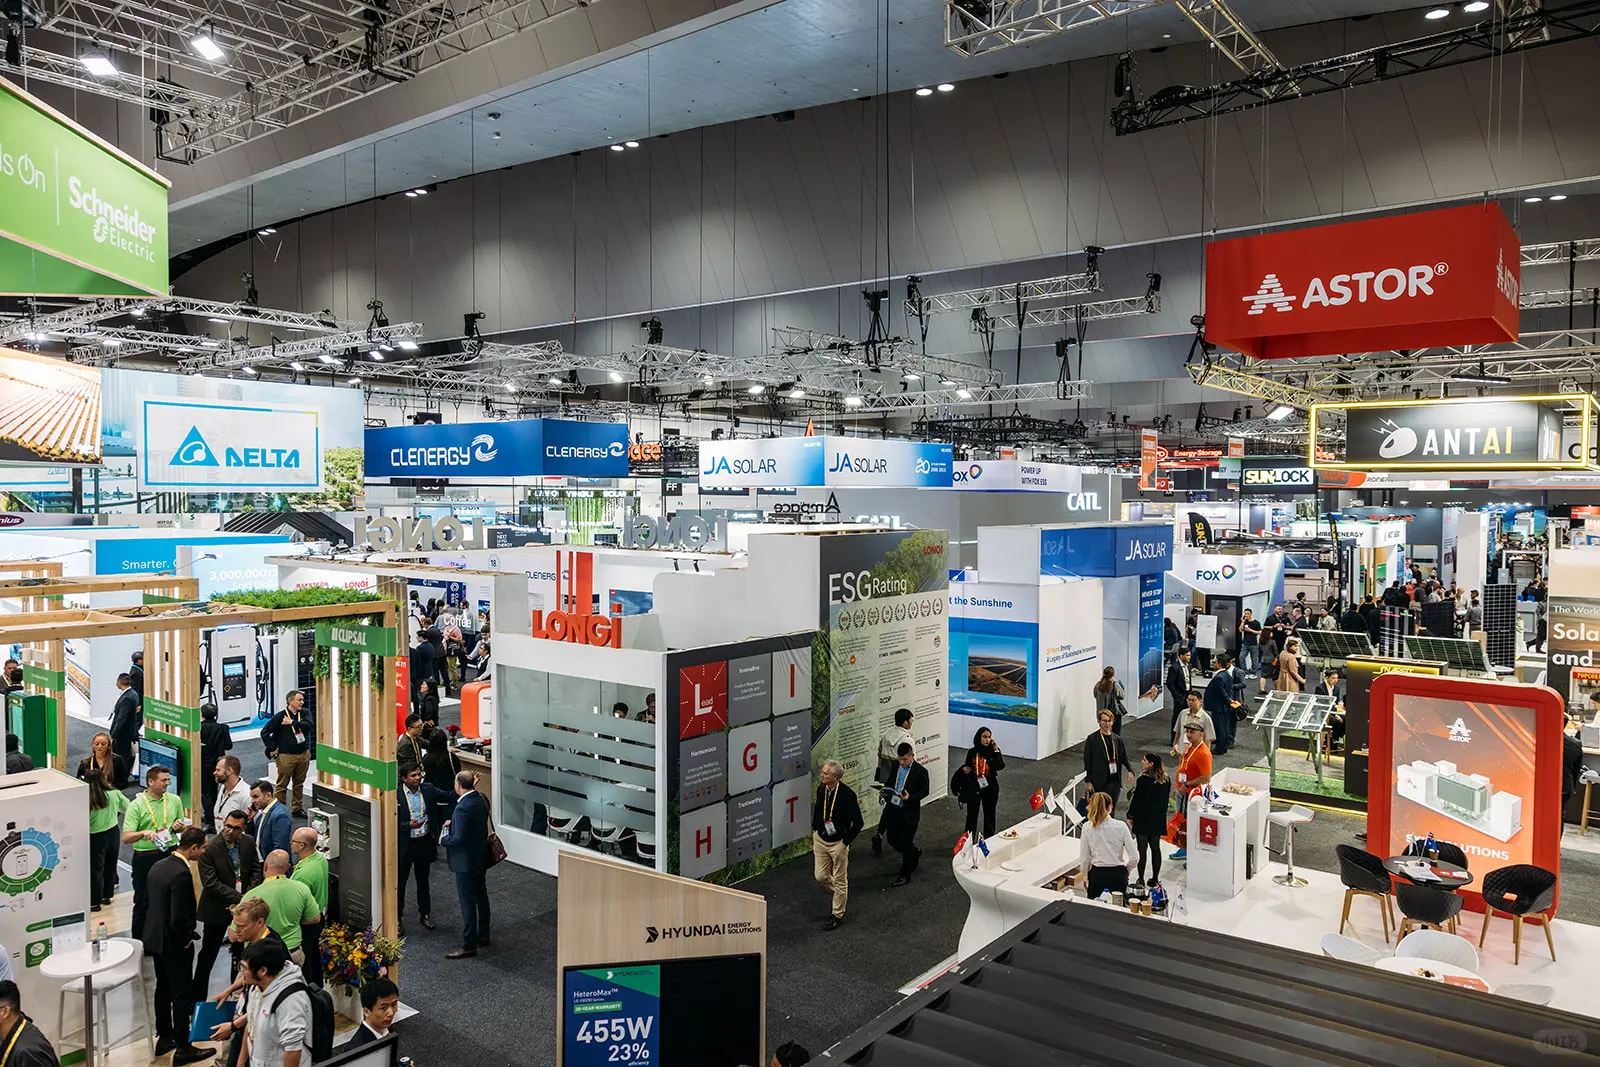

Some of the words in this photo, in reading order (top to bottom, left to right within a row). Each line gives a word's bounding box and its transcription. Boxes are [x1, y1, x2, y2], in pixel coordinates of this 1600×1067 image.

[18, 153, 46, 192] On
[68, 176, 156, 244] Schneider
[110, 226, 155, 263] Electric
[1422, 426, 1513, 456] ANTAI
[225, 447, 300, 469] DELTA
[391, 446, 470, 466] CLENERGY
[546, 446, 608, 459] CLENERGY
[628, 443, 662, 460] ace
[1174, 450, 1197, 458] Energy
[1198, 449, 1223, 457] Storage
[704, 455, 731, 475] JA
[733, 458, 777, 474] SOLAR
[829, 452, 854, 474] JA
[854, 457, 887, 474] SOLAR
[666, 483, 678, 491] FF
[1067, 492, 1102, 511] CATL
[1125, 539, 1142, 561] JA
[1142, 541, 1166, 559] SOLAR
[122, 560, 170, 570] Smarter.
[490, 559, 496, 567] 18
[209, 569, 266, 581] 3,000,000
[525, 571, 557, 581] CLENERG
[1196, 570, 1220, 581] FOX
[829, 570, 872, 604] ESG
[873, 576, 907, 596] Rating
[954, 596, 968, 606] the
[970, 597, 1013, 609] Sunshine
[1553, 605, 1570, 614] The
[444, 616, 472, 628] Coffee
[338, 629, 367, 646] CLIPSAL
[1552, 649, 1593, 667] and
[742, 742, 758, 772] G
[785, 796, 799, 824] T
[695, 825, 712, 859] H
[662, 924, 726, 939] HYUNDAI
[727, 926, 762, 935] SOLUTIONS
[595, 1003, 621, 1011] WARRANTY
[576, 1015, 654, 1044] 455W
[608, 1042, 650, 1062] 23%
